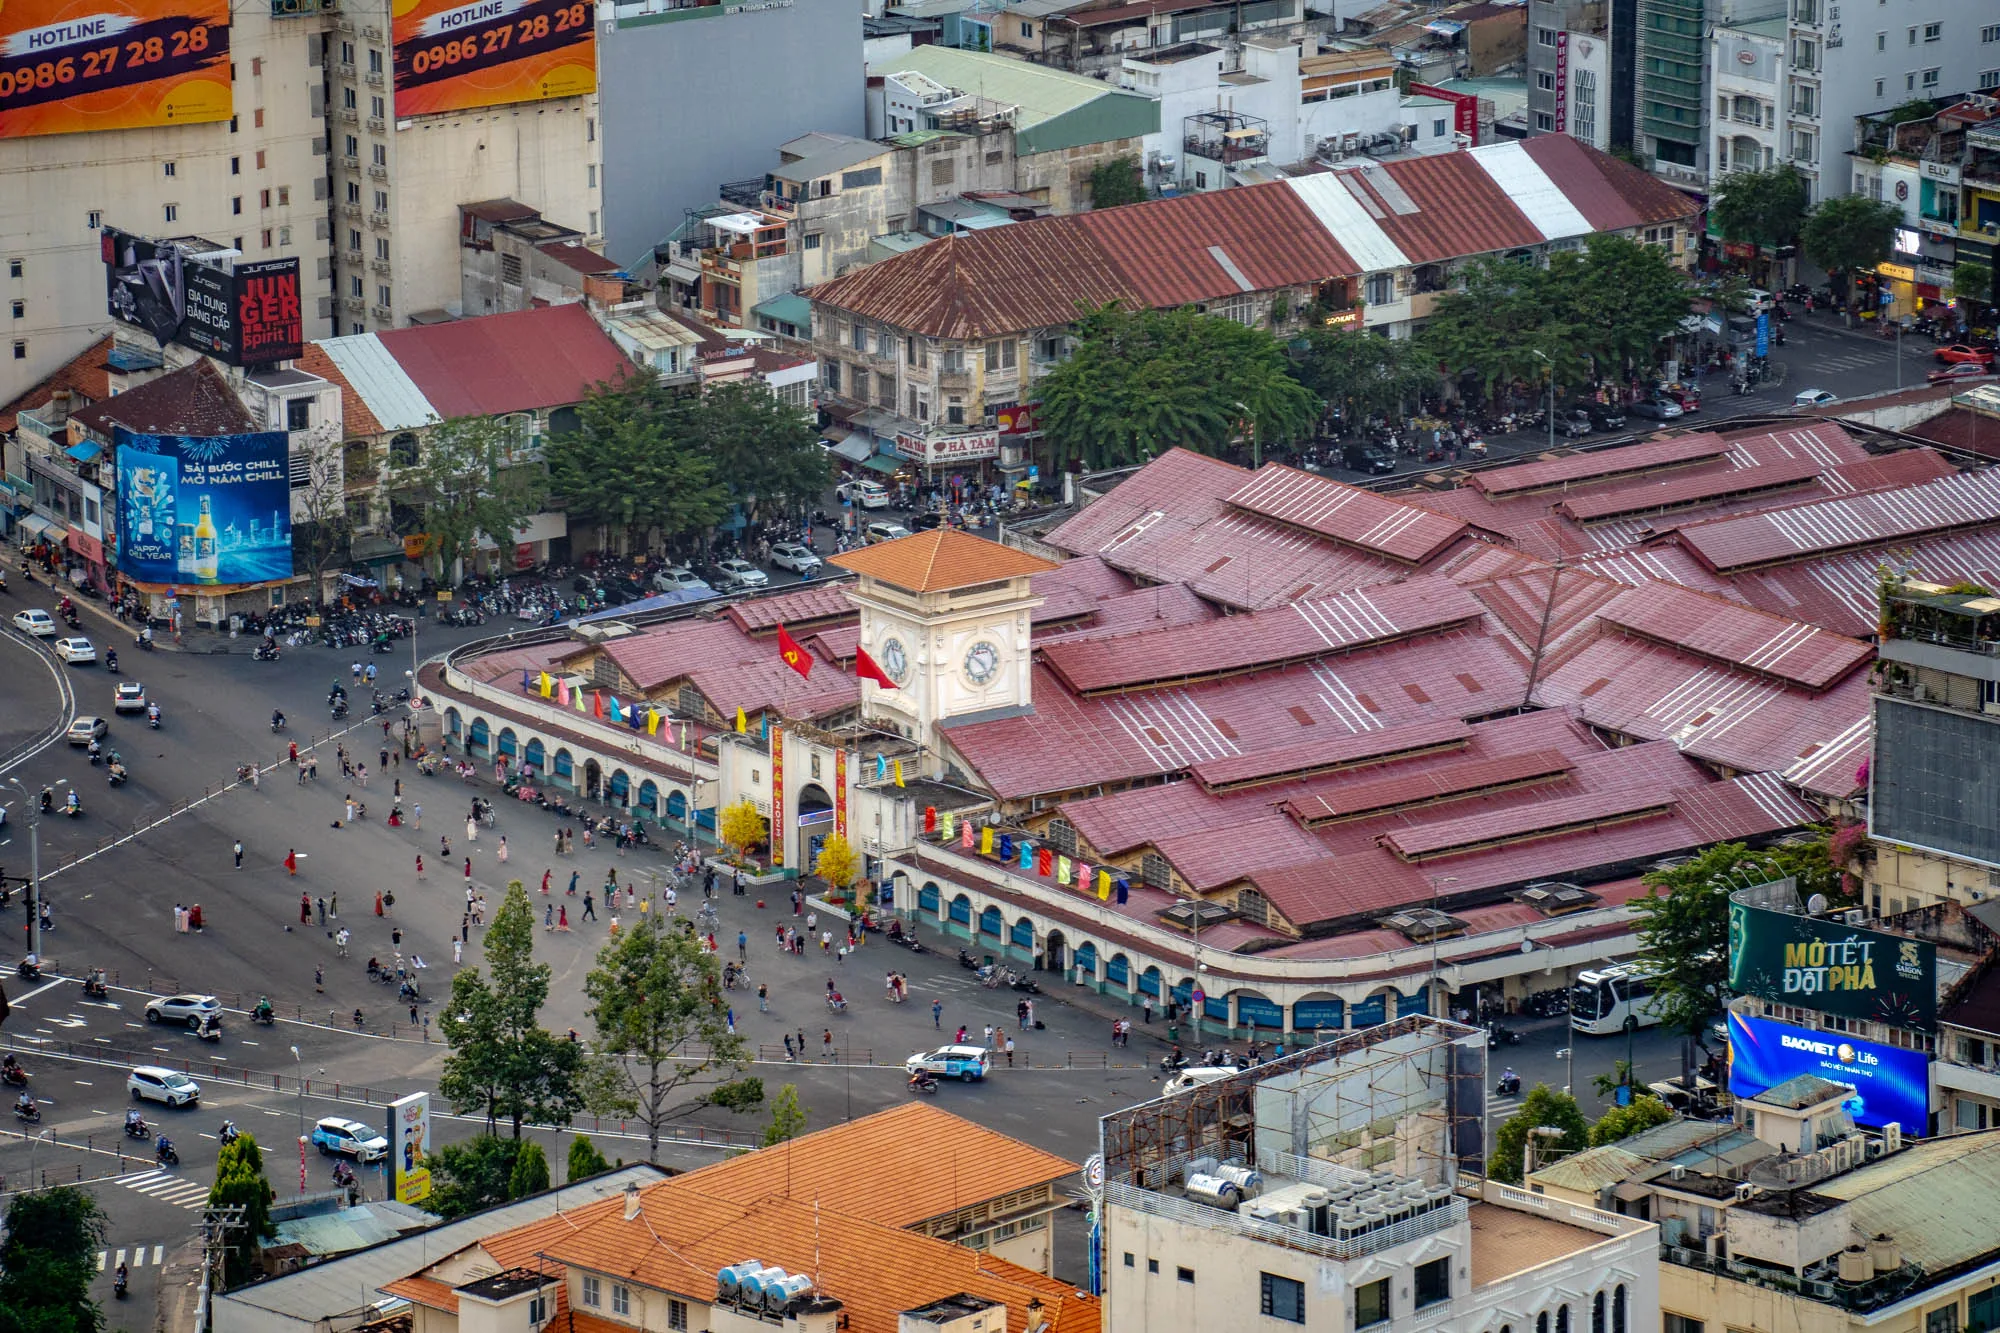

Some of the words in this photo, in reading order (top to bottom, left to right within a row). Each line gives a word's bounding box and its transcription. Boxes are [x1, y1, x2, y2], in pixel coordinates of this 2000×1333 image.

[441, 2, 502, 28] HOTLINE
[29, 20, 106, 48] HOTLINE
[413, 35, 478, 74] 0986
[483, 26, 513, 54] 27
[518, 15, 549, 44] 28
[554, 4, 586, 33] 28
[0, 57, 76, 98] 0986
[82, 47, 119, 78] 27
[126, 37, 163, 68] 28
[171, 26, 208, 57] 28
[1928, 164, 1949, 176] ELLY
[242, 260, 297, 274] JUNGER
[188, 289, 202, 304] GIA
[203, 294, 228, 314] DỤNG
[187, 303, 211, 324] ĐẲNG
[212, 314, 230, 331] CẤP
[948, 439, 967, 452] HÀ
[970, 437, 996, 449] TÂM
[181, 473, 206, 485] MỞ
[245, 470, 285, 482] CHILL
[184, 462, 205, 473] SẢI
[208, 461, 243, 473] BƯỚC
[245, 460, 280, 470] CHILL
[128, 549, 146, 560] CHILL
[146, 550, 172, 560] YEAR
[134, 543, 162, 553] HAPPY
[1785, 937, 1828, 967] MỞ
[1827, 934, 1876, 965] TẾT
[1783, 967, 1829, 996] ĐỘT
[1828, 958, 1877, 991] PHÁ
[1896, 964, 1923, 976] SAIGON
[1781, 1035, 1835, 1057] BAOVIET
[1857, 1050, 1879, 1066] Life
